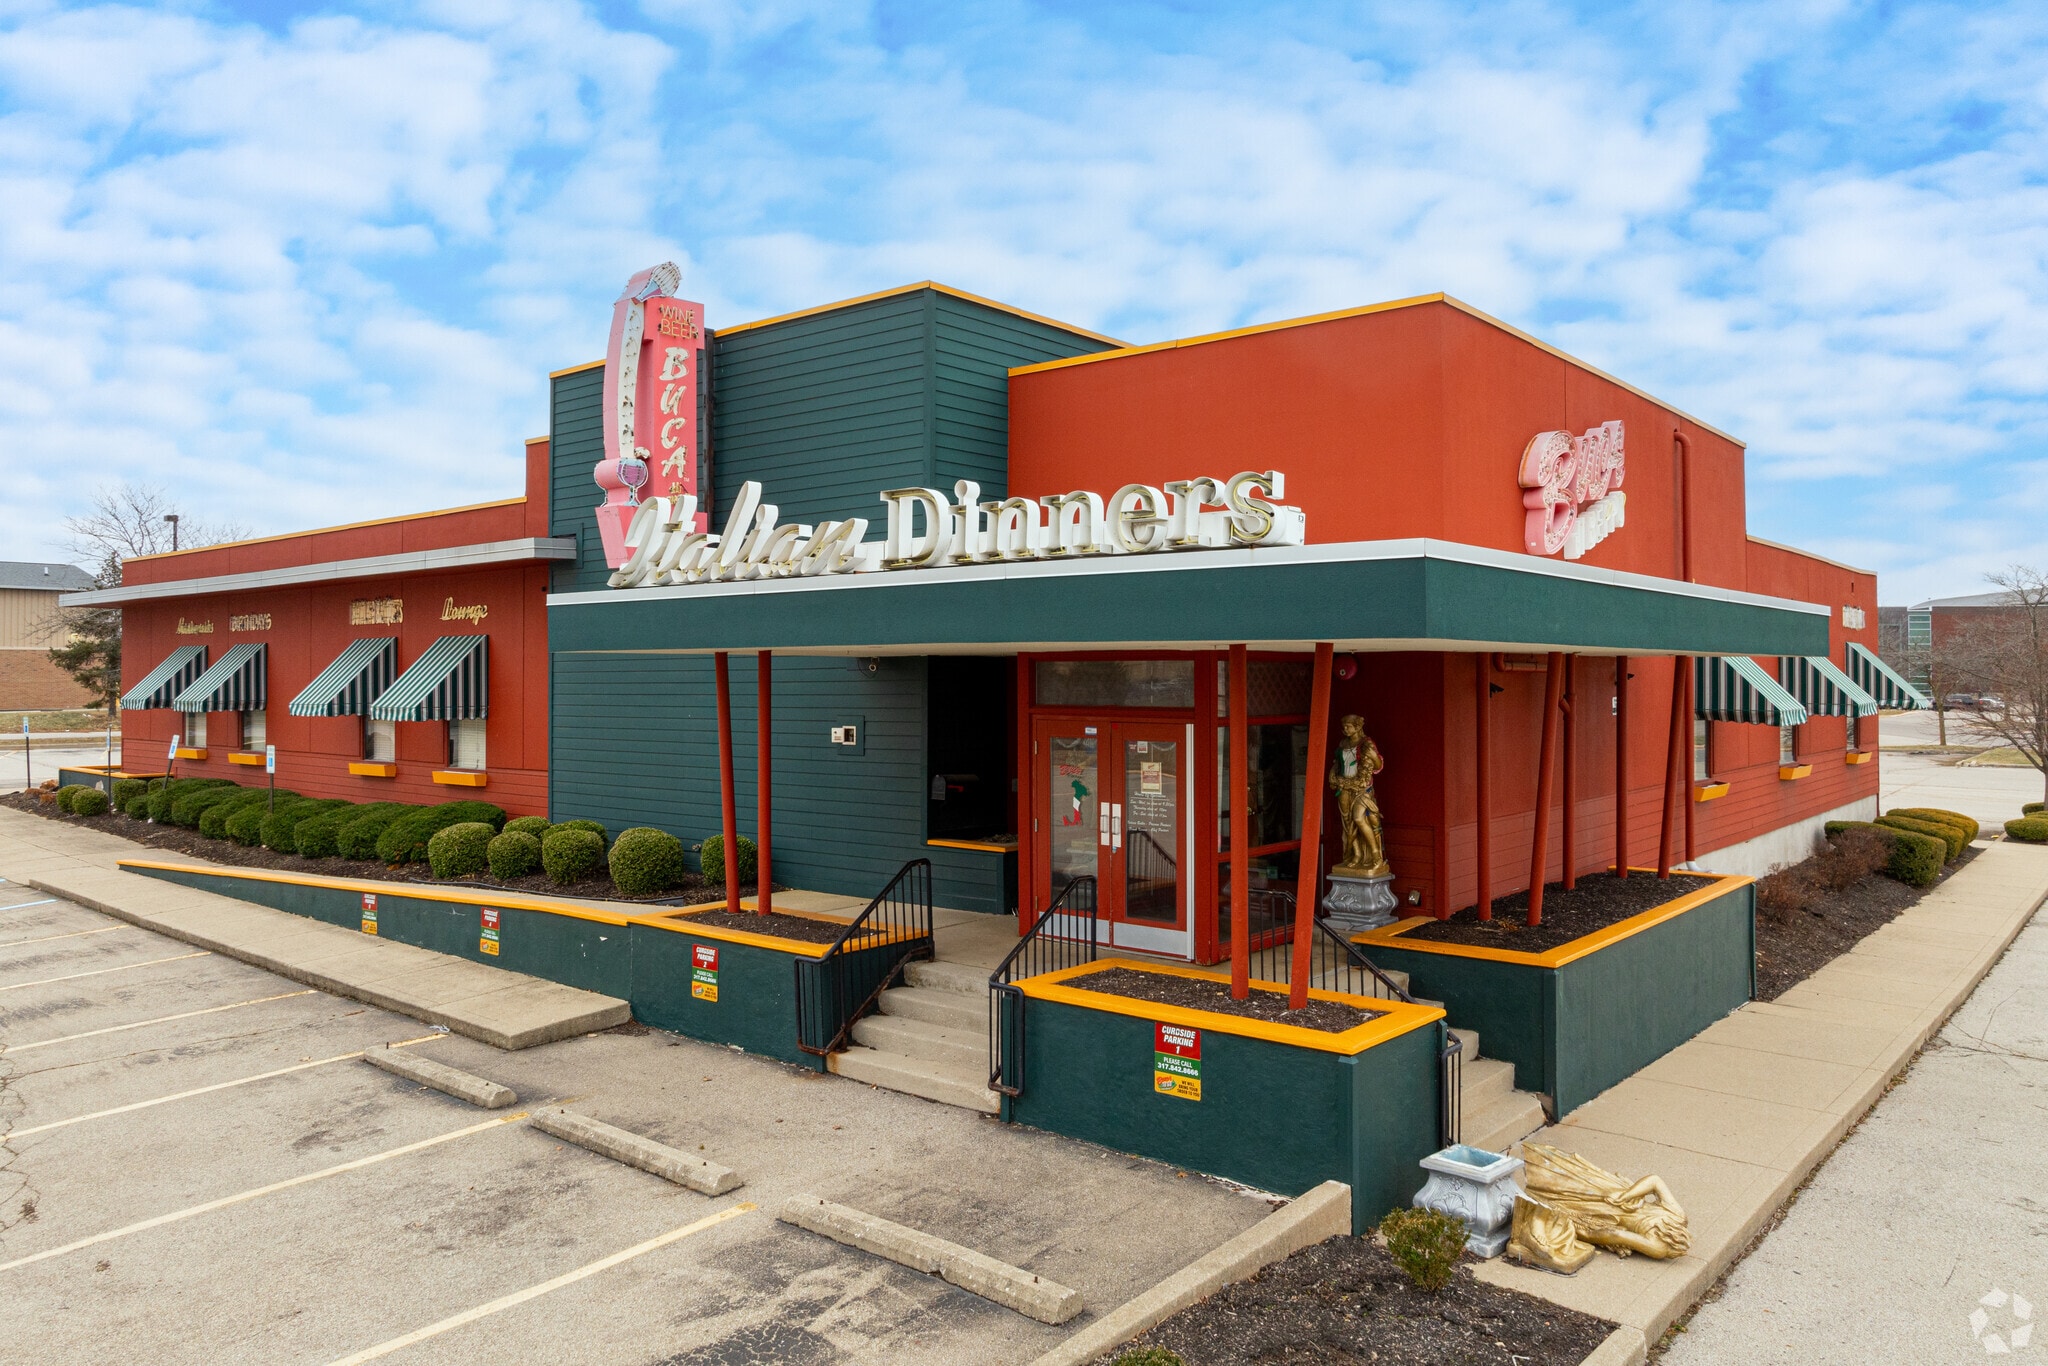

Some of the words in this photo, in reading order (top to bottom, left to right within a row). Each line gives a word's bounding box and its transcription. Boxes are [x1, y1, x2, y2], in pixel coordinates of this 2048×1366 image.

[659, 304, 695, 323] WINE
[660, 318, 699, 339] BEER
[659, 346, 690, 479] BUCA
[607, 480, 869, 589] Italian
[880, 470, 1286, 569] Dinners
[440, 597, 488, 626] Lounge
[1161, 1025, 1196, 1039] CURBSIDE
[1163, 1035, 1194, 1047] PARKING
[1176, 1045, 1180, 1054] 1
[1163, 1056, 1180, 1066] PLEASE
[1180, 1060, 1193, 1069] CALL
